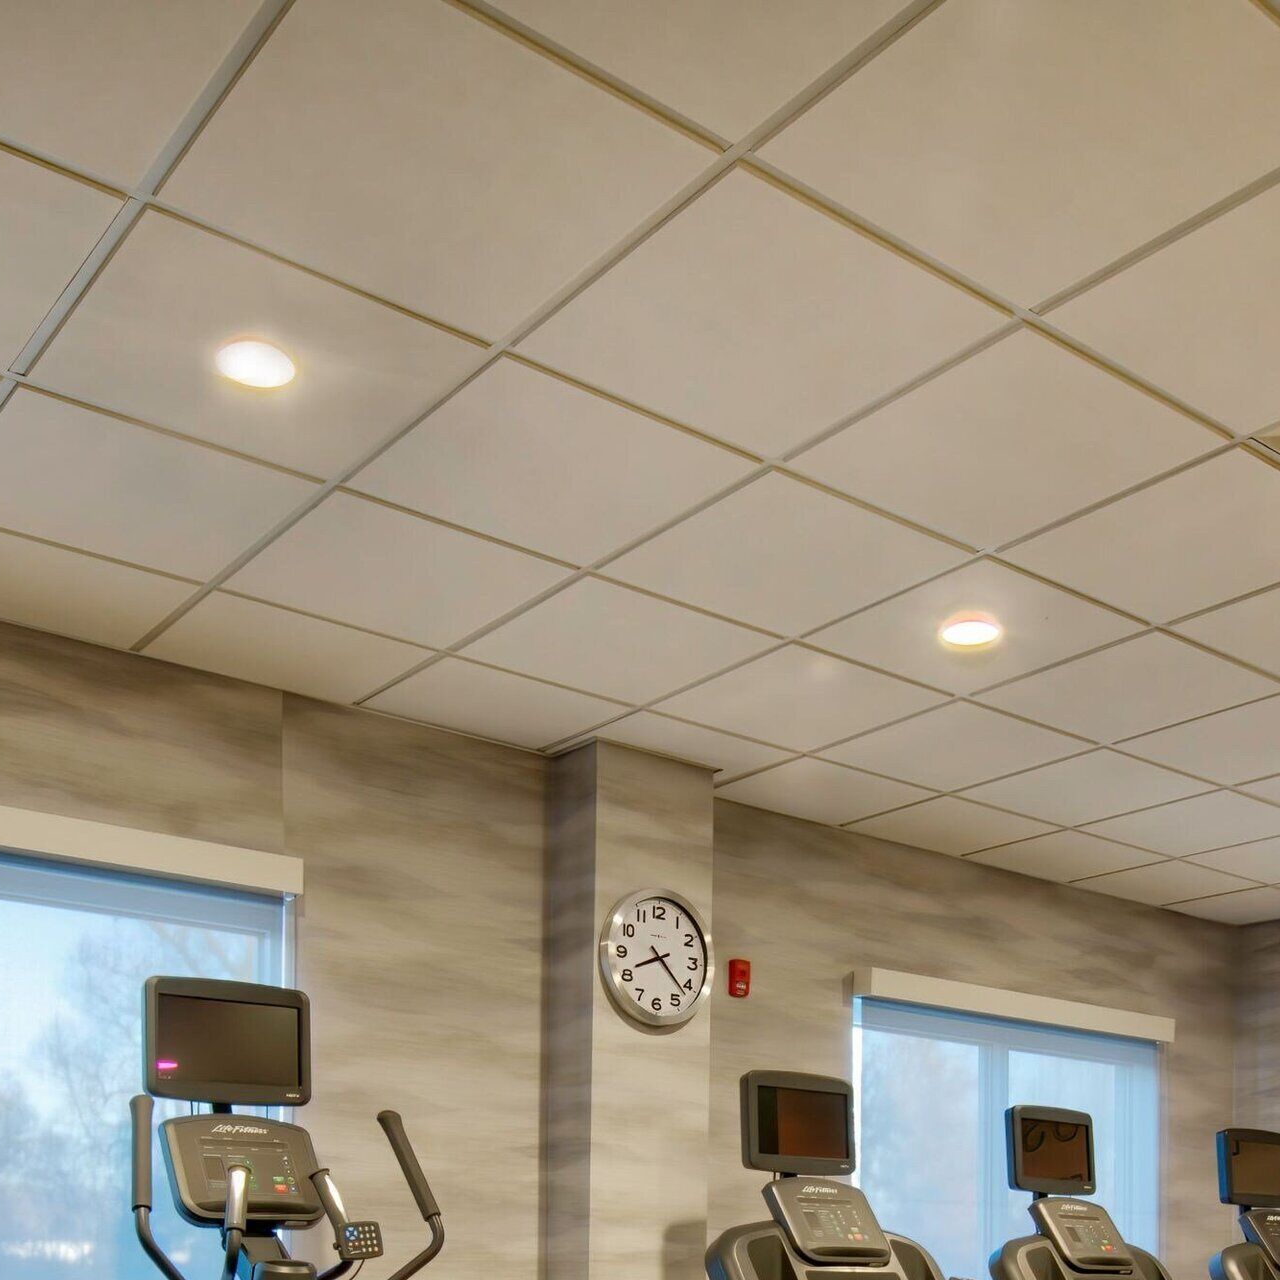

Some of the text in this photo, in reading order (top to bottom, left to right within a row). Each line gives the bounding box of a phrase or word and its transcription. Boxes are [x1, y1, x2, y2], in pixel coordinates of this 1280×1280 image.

[636, 908, 646, 923] 11
[652, 905, 666, 920] 12
[622, 923, 635, 938] 10
[683, 934, 694, 947] 2
[616, 945, 628, 958] 9
[686, 957, 698, 971] 3
[621, 968, 633, 982] 8
[683, 978, 693, 991] 4
[635, 987, 645, 1001] 7
[669, 993, 681, 1007] 5
[651, 997, 662, 1011] 6
